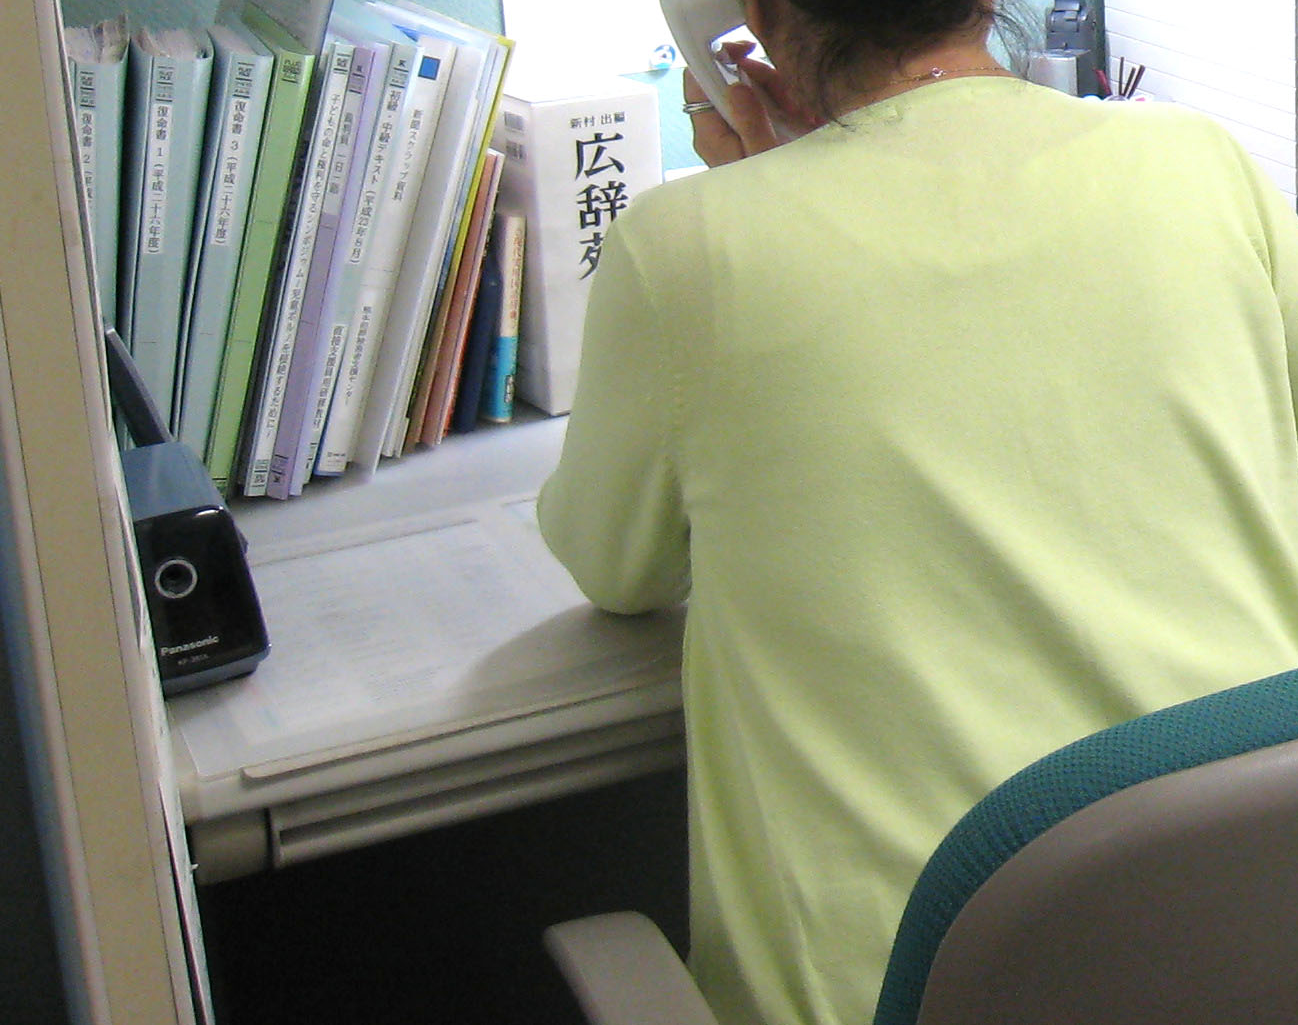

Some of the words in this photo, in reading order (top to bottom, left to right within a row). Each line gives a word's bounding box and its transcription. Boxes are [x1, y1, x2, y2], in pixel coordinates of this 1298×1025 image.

[156, 105, 170, 141] 復命書
[231, 101, 247, 135] 復命書
[370, 90, 402, 185] 初級・中級テキスト
[570, 117, 596, 129] 新村
[392, 109, 424, 202] 新聞スクラップ資料
[147, 163, 165, 254] (平成二十六年度)
[214, 156, 239, 244] (平成二十六年度)
[160, 634, 220, 657] Panasonic
